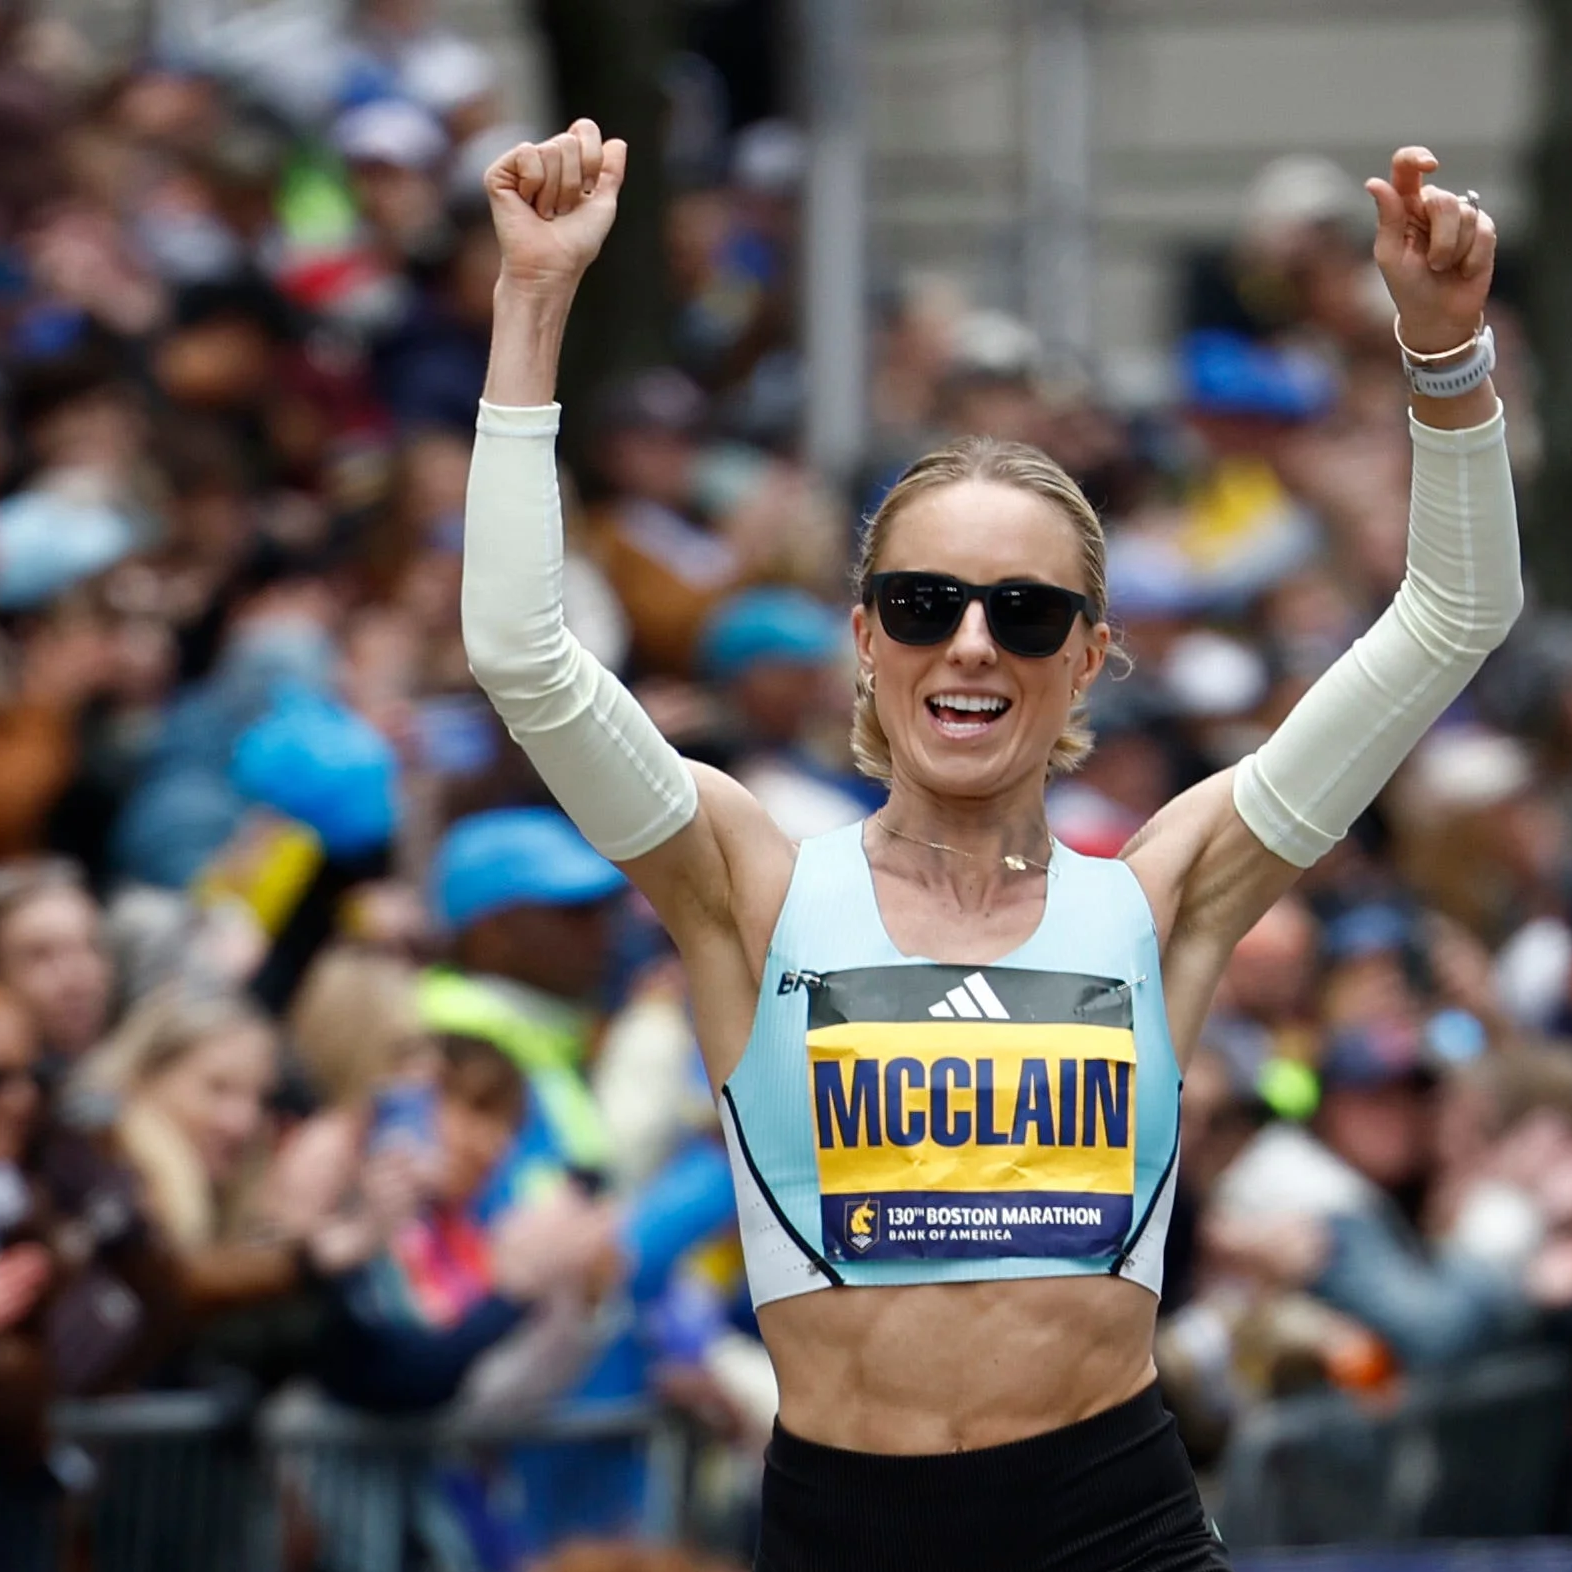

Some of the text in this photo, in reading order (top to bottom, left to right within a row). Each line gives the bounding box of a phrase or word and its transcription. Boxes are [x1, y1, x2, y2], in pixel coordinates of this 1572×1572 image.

[813, 1056, 1129, 1149] MCCLAIN
[926, 1206, 998, 1226] BOSTON
[1001, 1206, 1102, 1226] MARATHON
[888, 1229, 1012, 1241] BANK OF AMERICA
